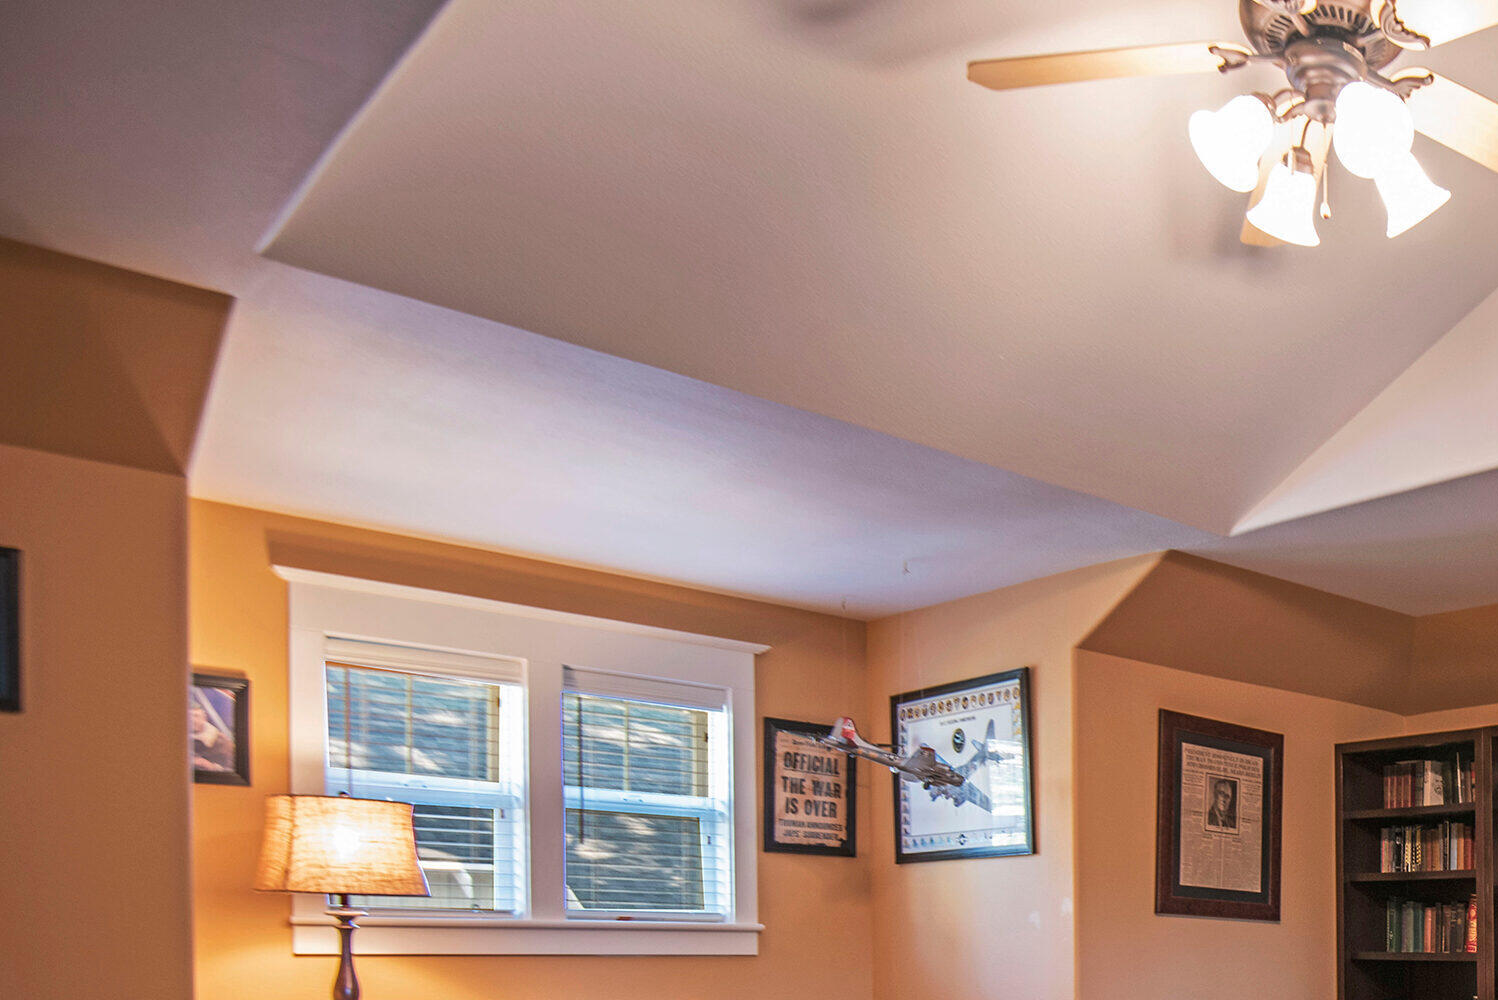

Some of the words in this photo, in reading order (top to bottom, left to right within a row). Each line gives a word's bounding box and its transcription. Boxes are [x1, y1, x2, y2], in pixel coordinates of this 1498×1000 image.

[783, 751, 840, 775] OFFICIAL
[781, 776, 806, 794] THE
[812, 780, 842, 799] WAR
[785, 798, 799, 814] IS
[804, 799, 837, 818] OVER
